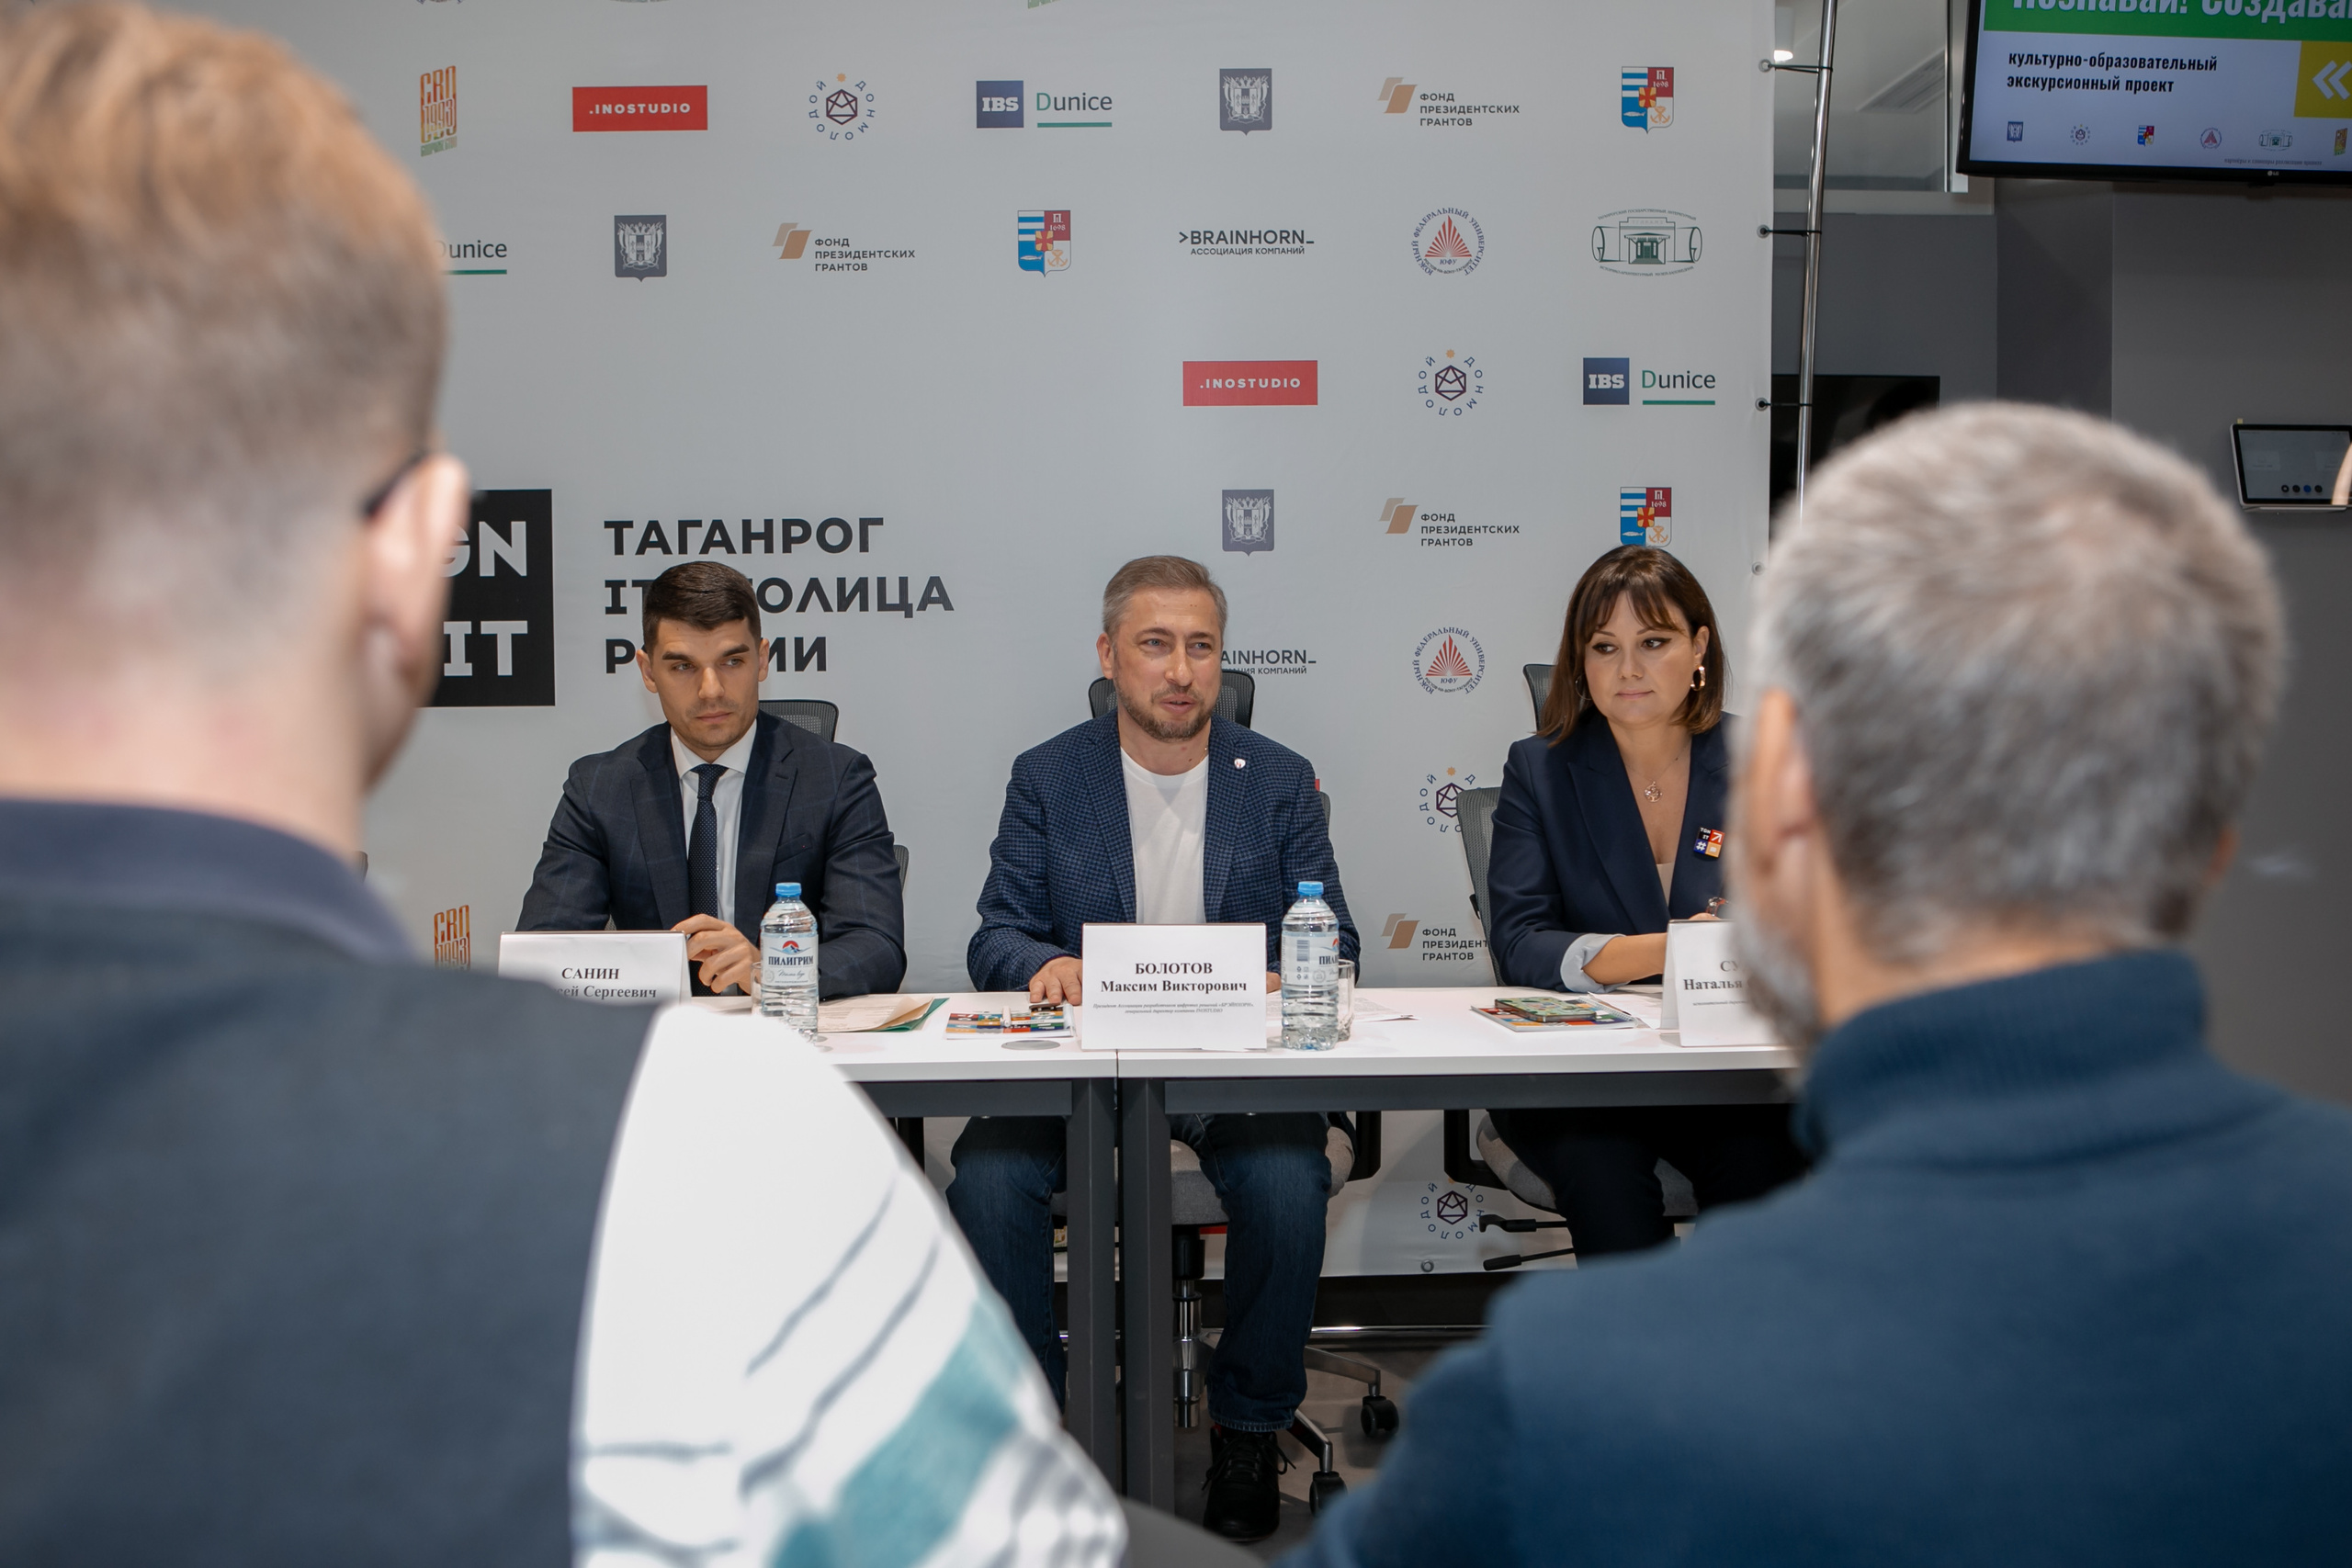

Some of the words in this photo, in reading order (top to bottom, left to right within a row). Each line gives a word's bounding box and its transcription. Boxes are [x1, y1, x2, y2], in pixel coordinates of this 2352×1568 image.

[2201, 0, 2352, 24] Создава
[2008, 51, 2218, 72] культурно-образовательный
[2007, 75, 2120, 93] экскурсионный
[2125, 78, 2175, 95] проект
[981, 96, 1019, 112] IBS
[1036, 92, 1113, 111] Dunice
[1419, 93, 1455, 103] ФОНД
[589, 103, 691, 115] .INOSTUDIO
[1419, 105, 1520, 116] ПРЕЗИДЕНТСКИХ
[1419, 118, 1473, 127] ГРАНТОВ
[1413, 208, 1469, 238] ФЕДЕРАЛЬНЫЙ
[814, 238, 850, 248] ФОНД
[1464, 217, 1485, 276] УНИВЕРСИТЕТ
[814, 249, 916, 260] ПРЕЗИДЕНТСКИХ
[1191, 247, 1253, 256] АССОЦИАЦИЯ
[1255, 245, 1305, 254] КОМПАНИЙ
[1411, 240, 1433, 276] ЮЖНЫЙ
[814, 263, 868, 272] ГРАНТОВ
[1199, 377, 1301, 389] .INOSTUDIO
[1588, 374, 1624, 389] IBS
[1641, 370, 1716, 389] Dunice
[1420, 513, 1455, 523] ФОНД
[604, 517, 884, 556] ТАГАНРОГ
[1420, 524, 1520, 536] ПРЕЗИДЕНТСКИХ
[1420, 536, 1474, 547] ГРАНТОВ
[440, 521, 526, 578] GN
[750, 576, 955, 618] ОЛИЦА
[443, 620, 528, 676] IT
[1415, 626, 1470, 658] ФЕДЕРАЛЬНЫЙ
[605, 637, 827, 674] РИИ
[1222, 649, 1317, 664] AINHORN_
[1258, 665, 1307, 674] КОМПАНИЙ
[1464, 637, 1485, 694] УНИВЕРСИТЕТ
[1412, 660, 1434, 694] ЮЖНЫЙ
[1422, 928, 1456, 938] ФОНД
[1422, 940, 1488, 950] ПРЕЗИДЕНТ
[768, 955, 814, 965] ПИЛИГРИМ
[1422, 952, 1475, 961] ГРАНТОВ
[561, 967, 620, 980] САНИН
[1135, 963, 1213, 975] БОЛОТОВ
[1101, 980, 1158, 992] Максим
[1162, 980, 1247, 994] Викторович
[1683, 978, 1743, 990] Наталья
[583, 985, 657, 1000] Сергеевич
